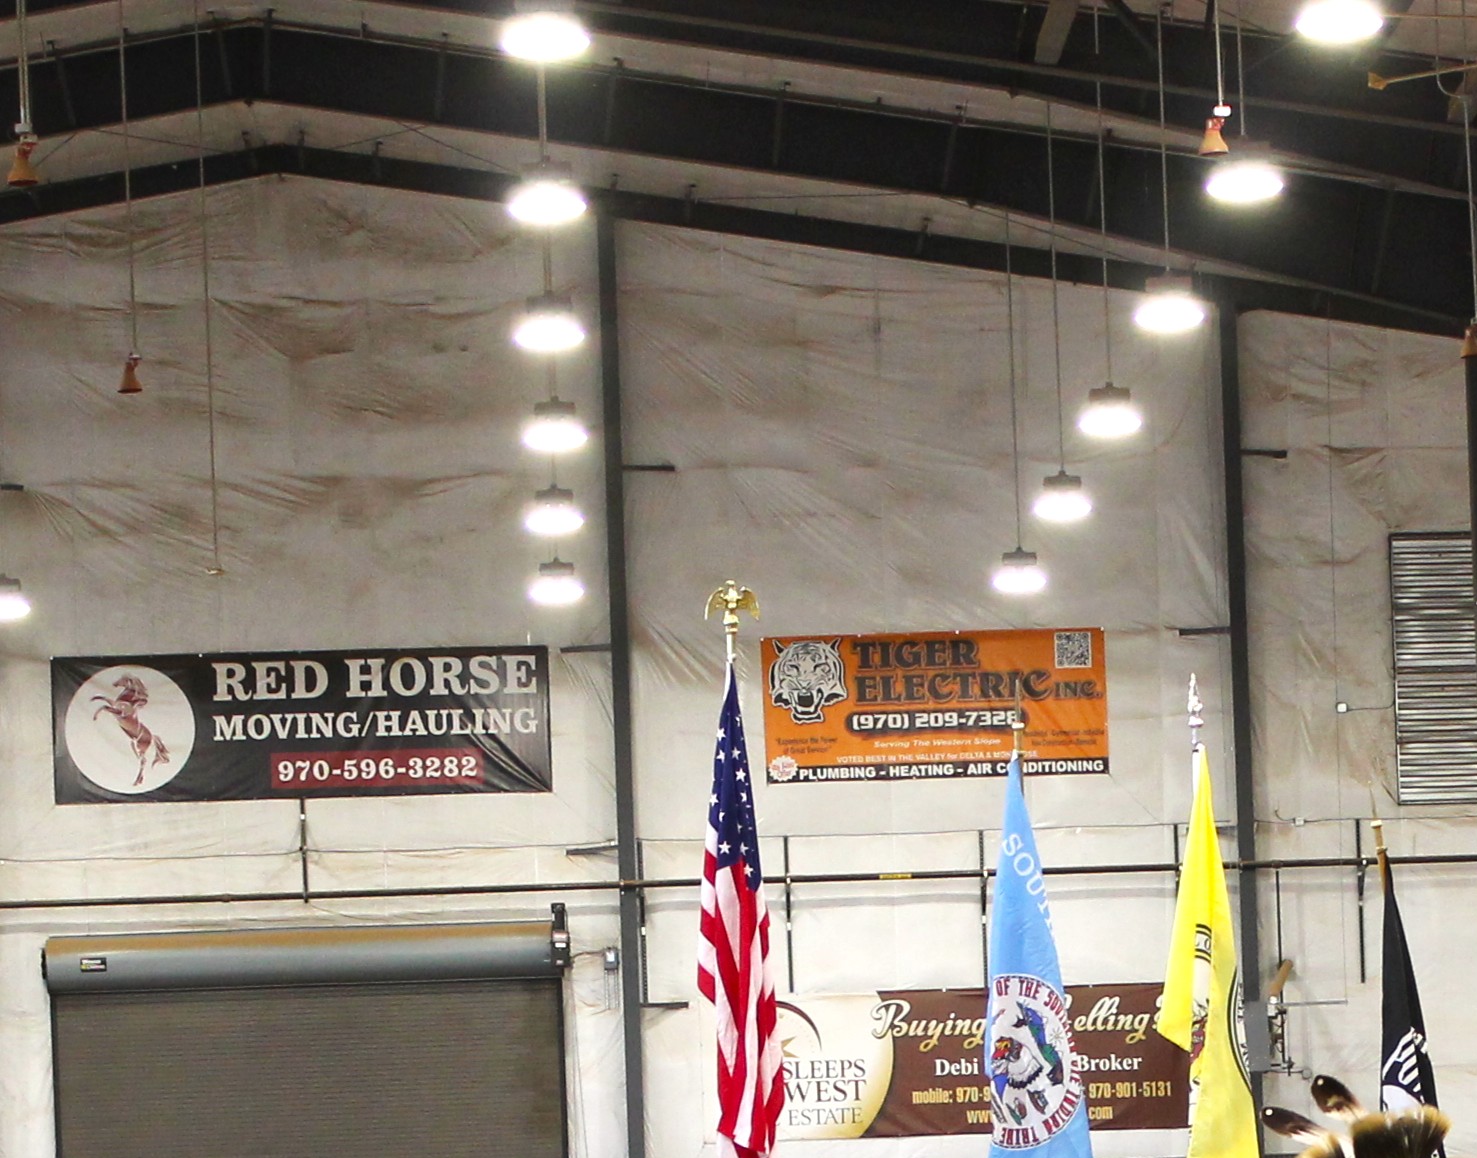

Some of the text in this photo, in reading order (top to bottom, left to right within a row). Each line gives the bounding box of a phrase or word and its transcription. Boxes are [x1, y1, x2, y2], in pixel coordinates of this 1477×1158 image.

[852, 639, 979, 671] TIGER
[212, 654, 538, 701] RED HORSE
[853, 669, 1102, 705] ELECTRIC INC.
[212, 707, 538, 742] MOVING/HAULING
[852, 711, 1017, 731] (970) 209-7328
[874, 740, 910, 748] Serving
[933, 738, 971, 746] Western
[974, 737, 1001, 746] Slope
[277, 755, 478, 782] 970-596-3282
[836, 756, 863, 764] VOTED
[865, 755, 886, 763] BEST
[899, 754, 914, 762] THE
[916, 753, 946, 761] VALLEY
[960, 752, 985, 760] DELTA
[800, 767, 876, 780] PLUMBING
[889, 764, 954, 778] HEATING
[967, 762, 992, 775] AIR
[996, 760, 1104, 774] CDITIONING
[996, 979, 1011, 997] OF
[1019, 980, 1041, 1001] THE
[870, 999, 987, 1052] Buying
[782, 1059, 866, 1080] SLEEPS
[935, 1054, 1142, 1076] Debi Broker
[783, 1079, 867, 1103] WEST
[912, 1088, 953, 1104] mobile:
[1088, 1081, 1171, 1099] 970-901-5131
[788, 1107, 864, 1127] ESTATE
